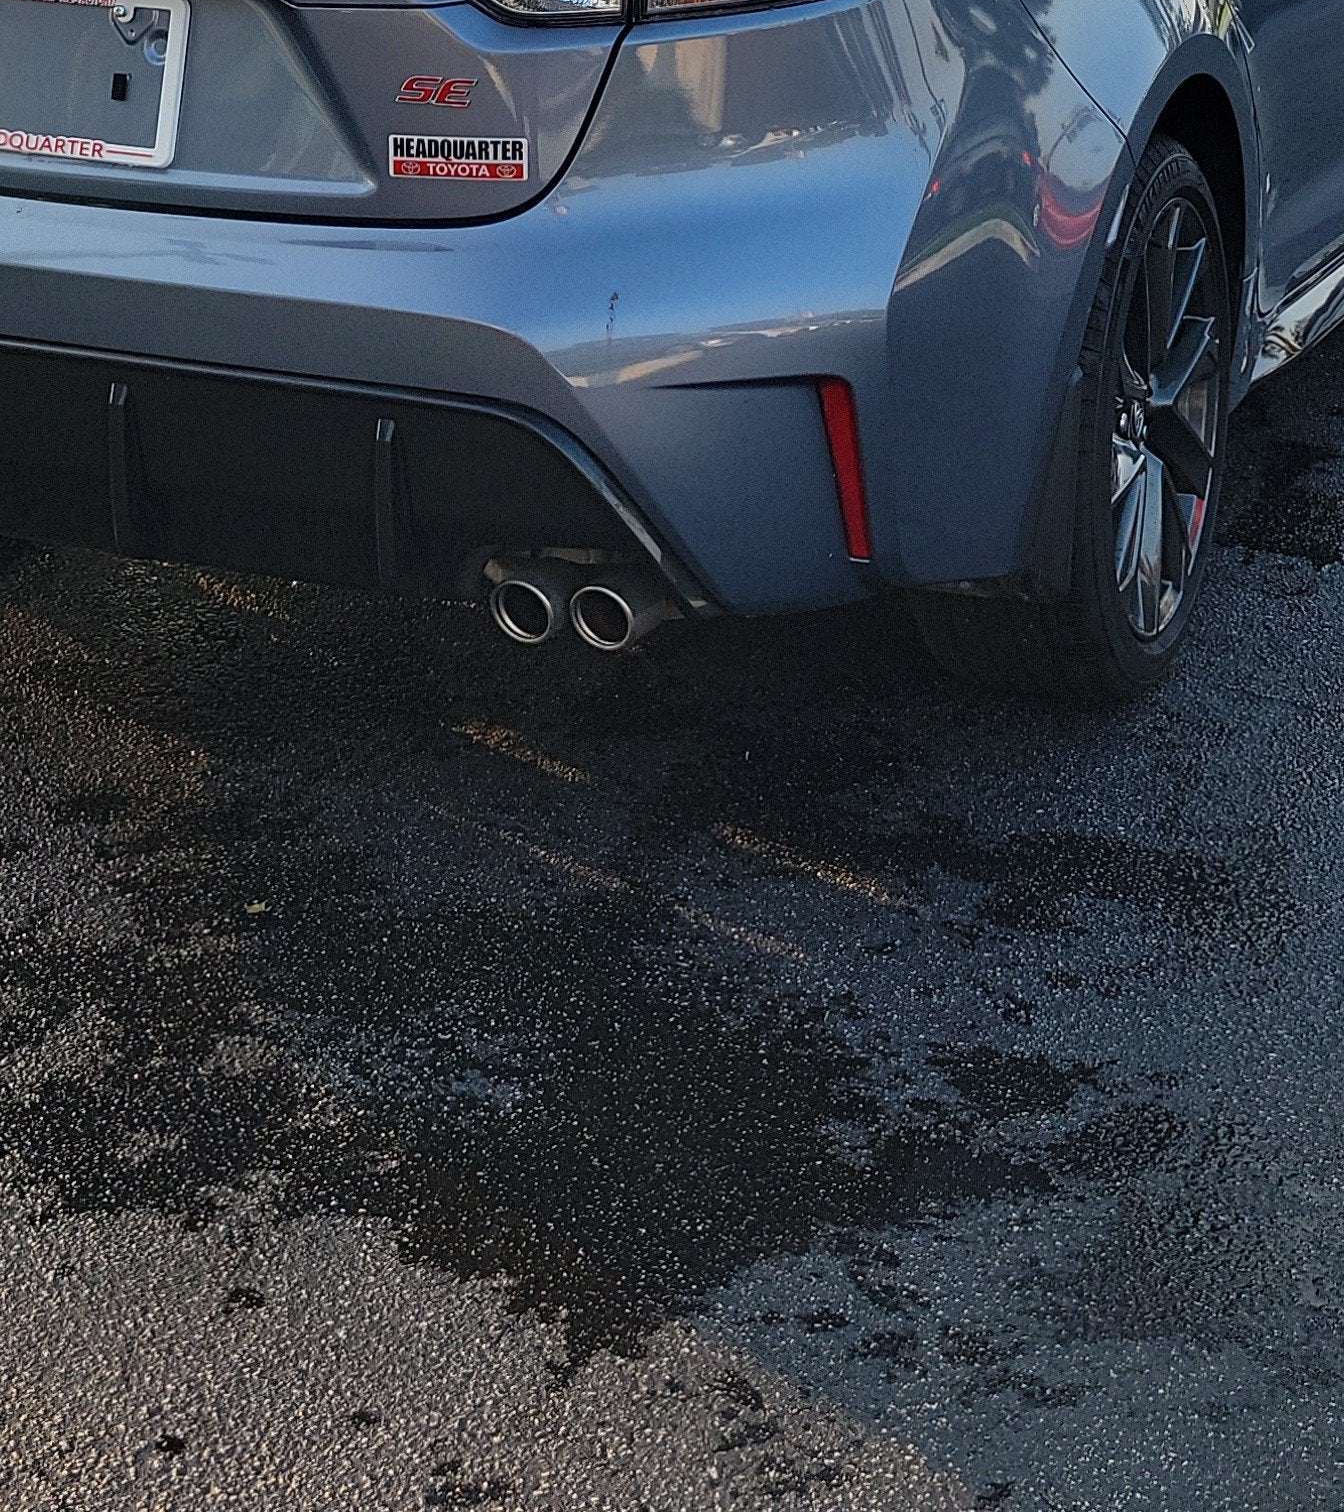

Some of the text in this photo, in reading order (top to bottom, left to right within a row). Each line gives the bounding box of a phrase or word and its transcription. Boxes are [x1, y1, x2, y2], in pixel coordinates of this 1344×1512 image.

[395, 75, 478, 108] SE
[393, 137, 524, 161] HEADQUARTER
[426, 162, 490, 177] TOYOTA
